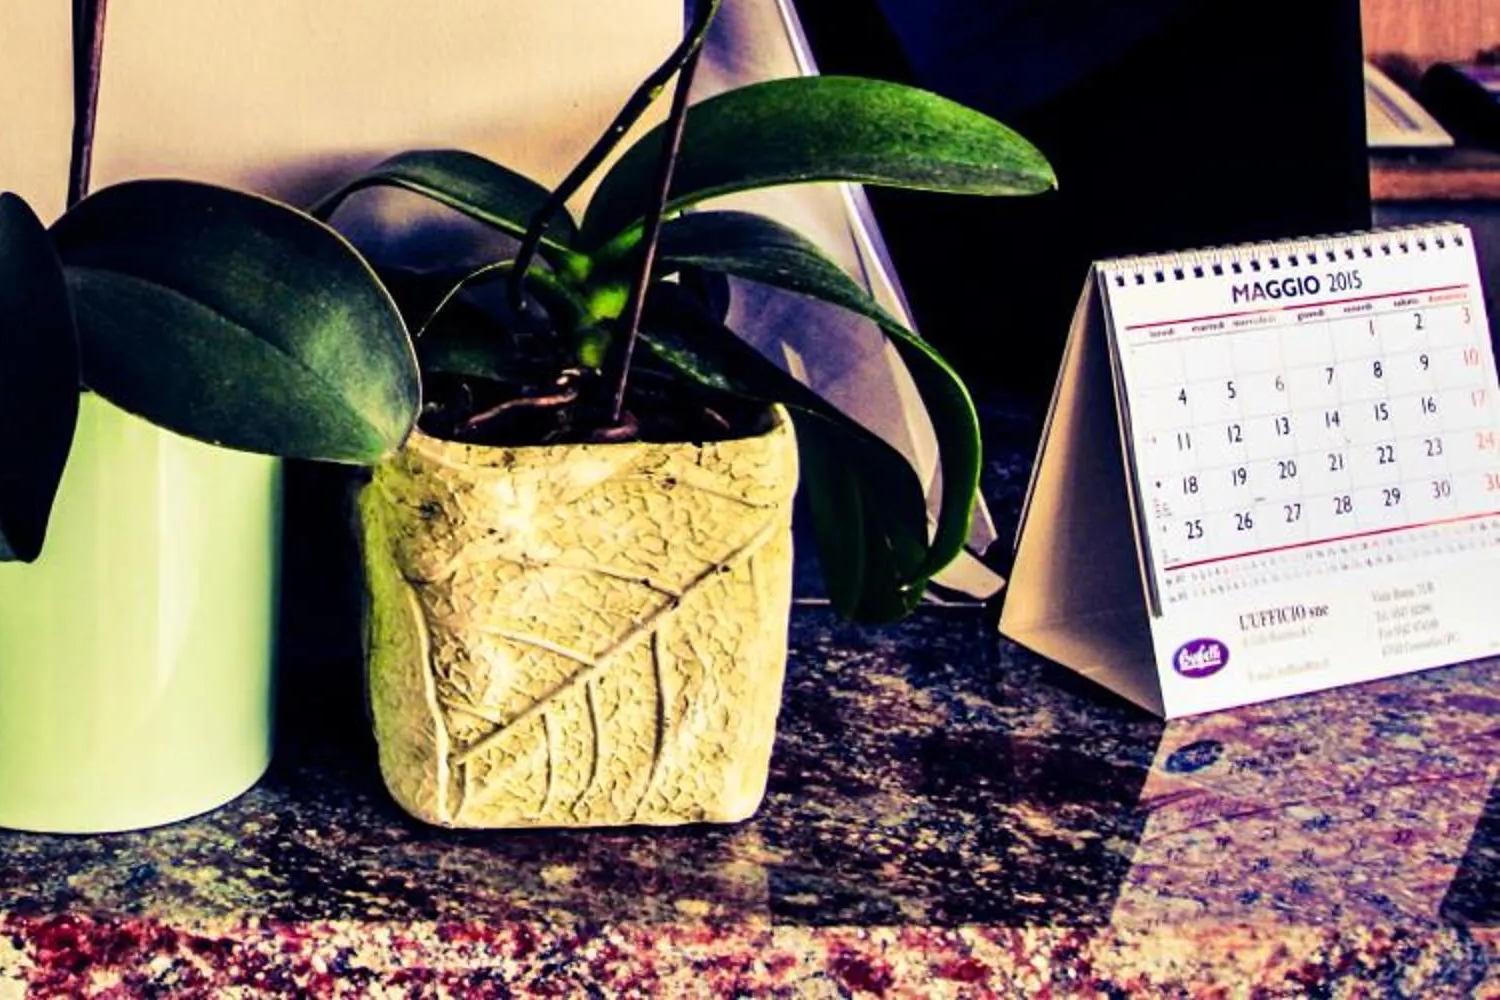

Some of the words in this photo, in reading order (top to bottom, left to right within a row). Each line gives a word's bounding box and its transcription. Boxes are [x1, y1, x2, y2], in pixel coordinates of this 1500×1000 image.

[1231, 275, 1321, 303] MAGGIO
[1326, 270, 1363, 293] 2015
[1413, 312, 1424, 331] 2
[1461, 306, 1472, 325] 3
[1177, 387, 1188, 406] 4
[1226, 380, 1237, 400] 5
[1275, 375, 1285, 392] 6
[1325, 366, 1335, 386] 7
[1372, 360, 1383, 379] 8
[1419, 353, 1430, 371] 9
[1462, 349, 1480, 367] 10
[1176, 431, 1192, 451] 11
[1226, 423, 1243, 444] 12
[1274, 416, 1291, 436] 13
[1325, 410, 1341, 429] 14
[1373, 402, 1390, 422] 15
[1420, 396, 1438, 415] 16
[1470, 388, 1487, 408] 17
[1182, 475, 1199, 495] 18
[1231, 466, 1248, 487] 19
[1276, 459, 1298, 480] 20
[1327, 453, 1344, 472] 21
[1375, 445, 1396, 465] 22
[1423, 437, 1444, 457] 23
[1474, 431, 1496, 450] 24
[1184, 518, 1205, 540] 25
[1234, 511, 1254, 532] 26
[1283, 502, 1302, 524] 27
[1333, 495, 1353, 516] 28
[1381, 487, 1402, 508] 29
[1431, 479, 1452, 500] 30
[1483, 472, 1500, 492] 31
[1239, 603, 1307, 630] L'UFFICIO
